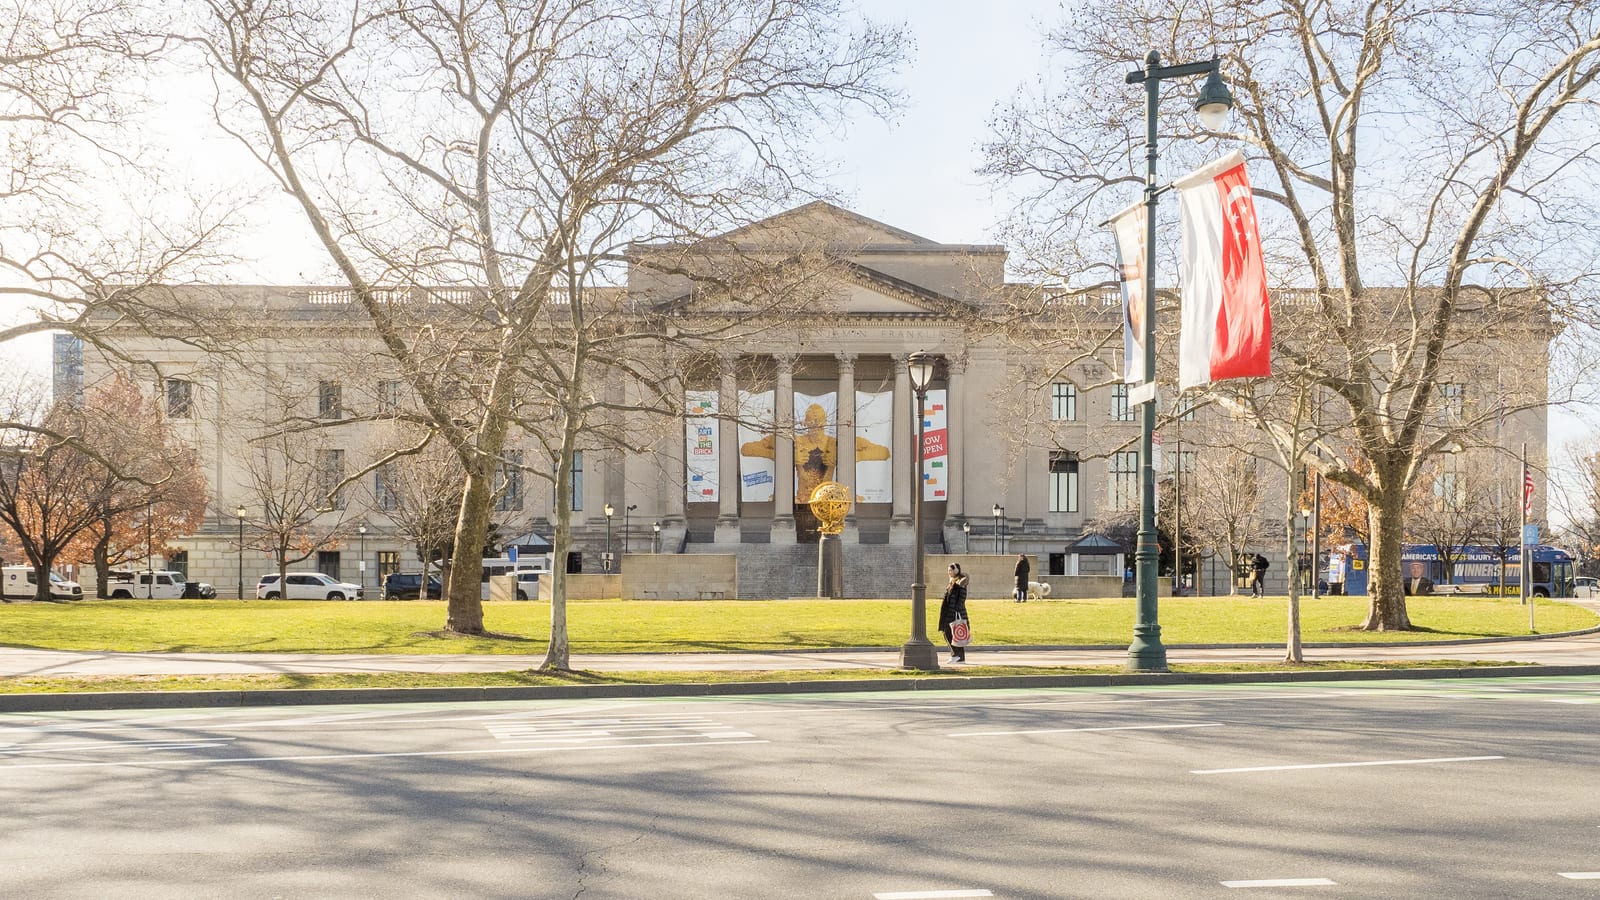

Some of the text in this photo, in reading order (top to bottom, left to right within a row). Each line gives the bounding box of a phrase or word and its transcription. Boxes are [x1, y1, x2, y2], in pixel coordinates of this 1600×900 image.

[924, 435, 940, 446] OW
[1455, 563, 1502, 576] WINNERS
[1493, 586, 1521, 595] MRGAN
